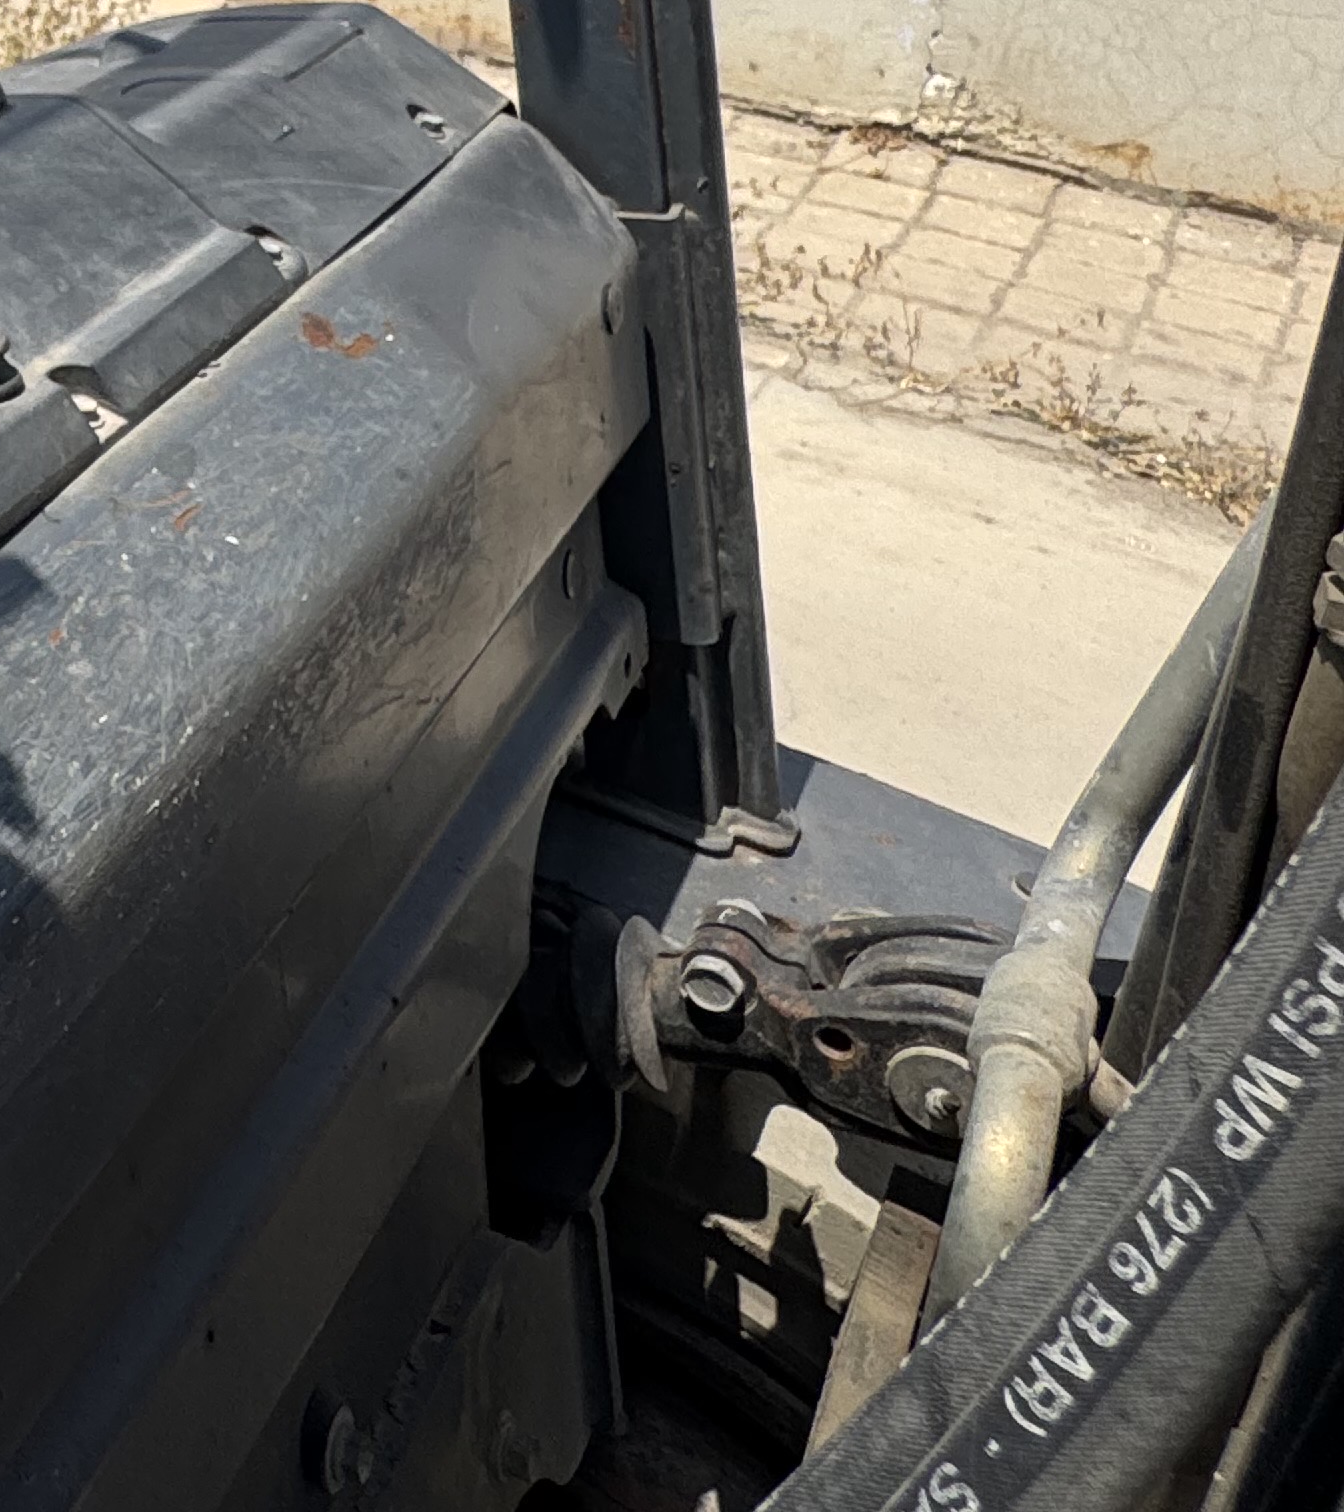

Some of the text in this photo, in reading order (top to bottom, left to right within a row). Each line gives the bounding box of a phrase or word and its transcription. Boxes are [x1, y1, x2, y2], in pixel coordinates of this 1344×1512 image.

[1214, 1053, 1304, 1163] WP
[1108, 1167, 1216, 1296] (276
[1003, 1282, 1133, 1439] BAR)
